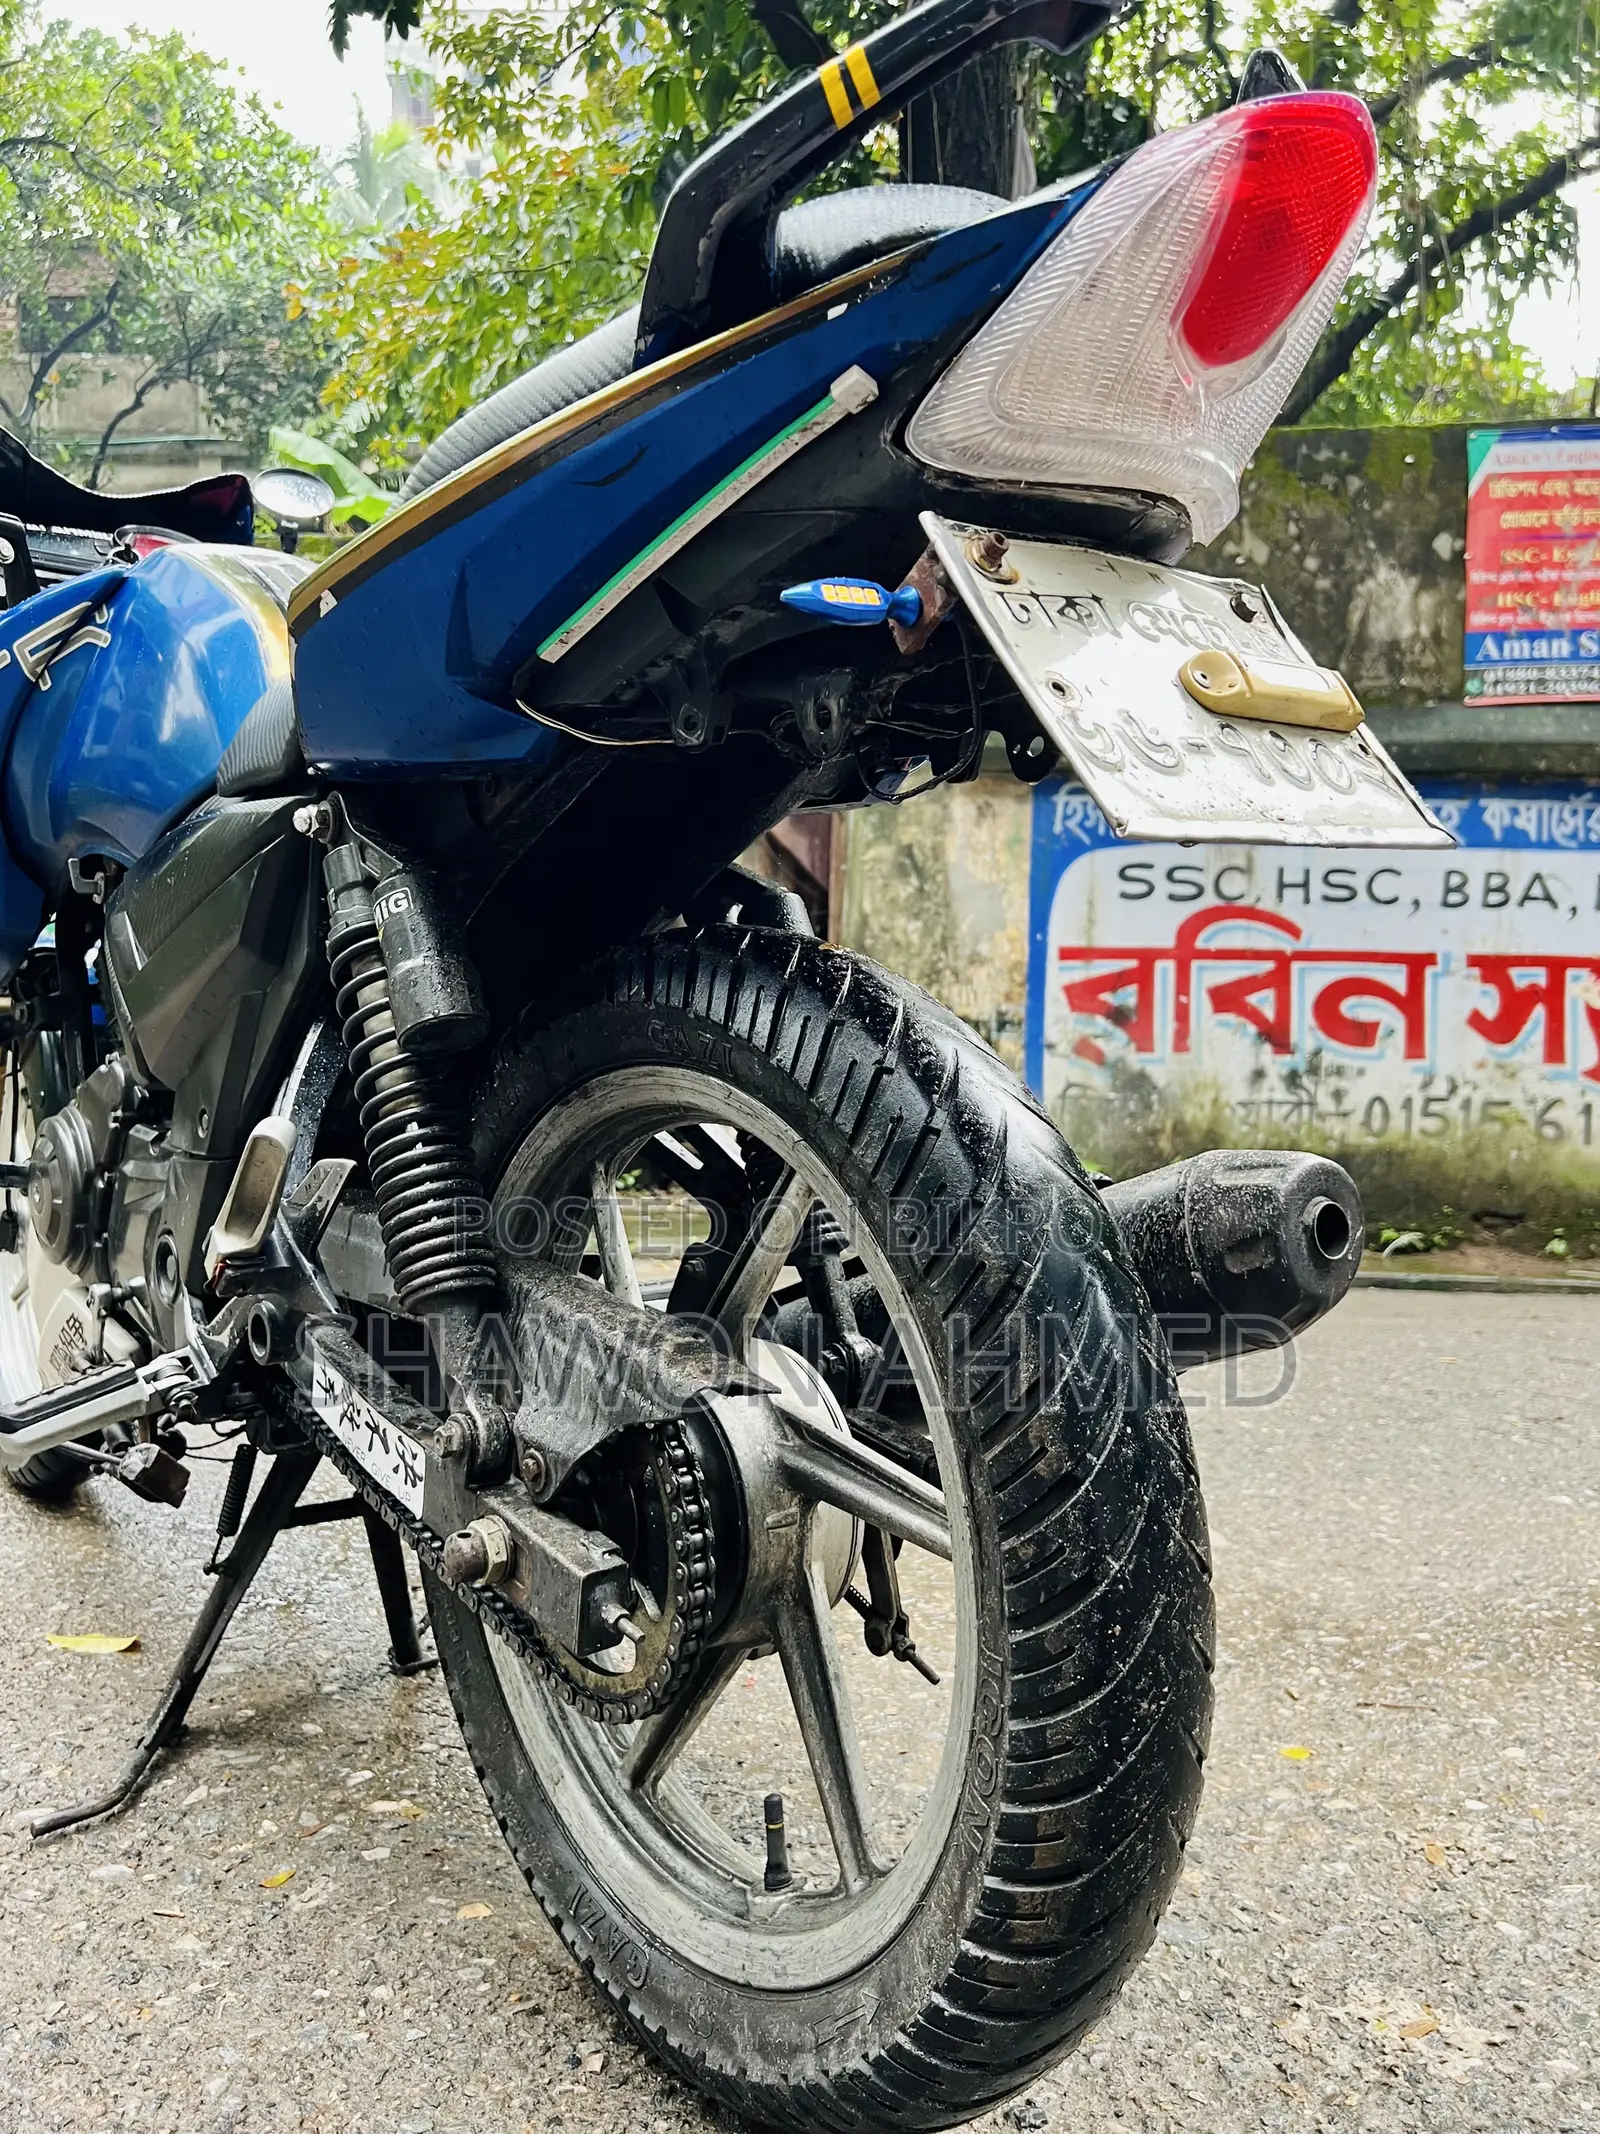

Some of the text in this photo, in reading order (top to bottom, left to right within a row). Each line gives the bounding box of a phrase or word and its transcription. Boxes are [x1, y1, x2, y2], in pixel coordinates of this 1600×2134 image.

[1475, 633, 1571, 661] Aman
[1057, 903, 1440, 1067] রবিন
[370, 1462, 393, 1489] GIVE
[397, 1484, 412, 1503] UP
[566, 1881, 651, 1990] GAZI
